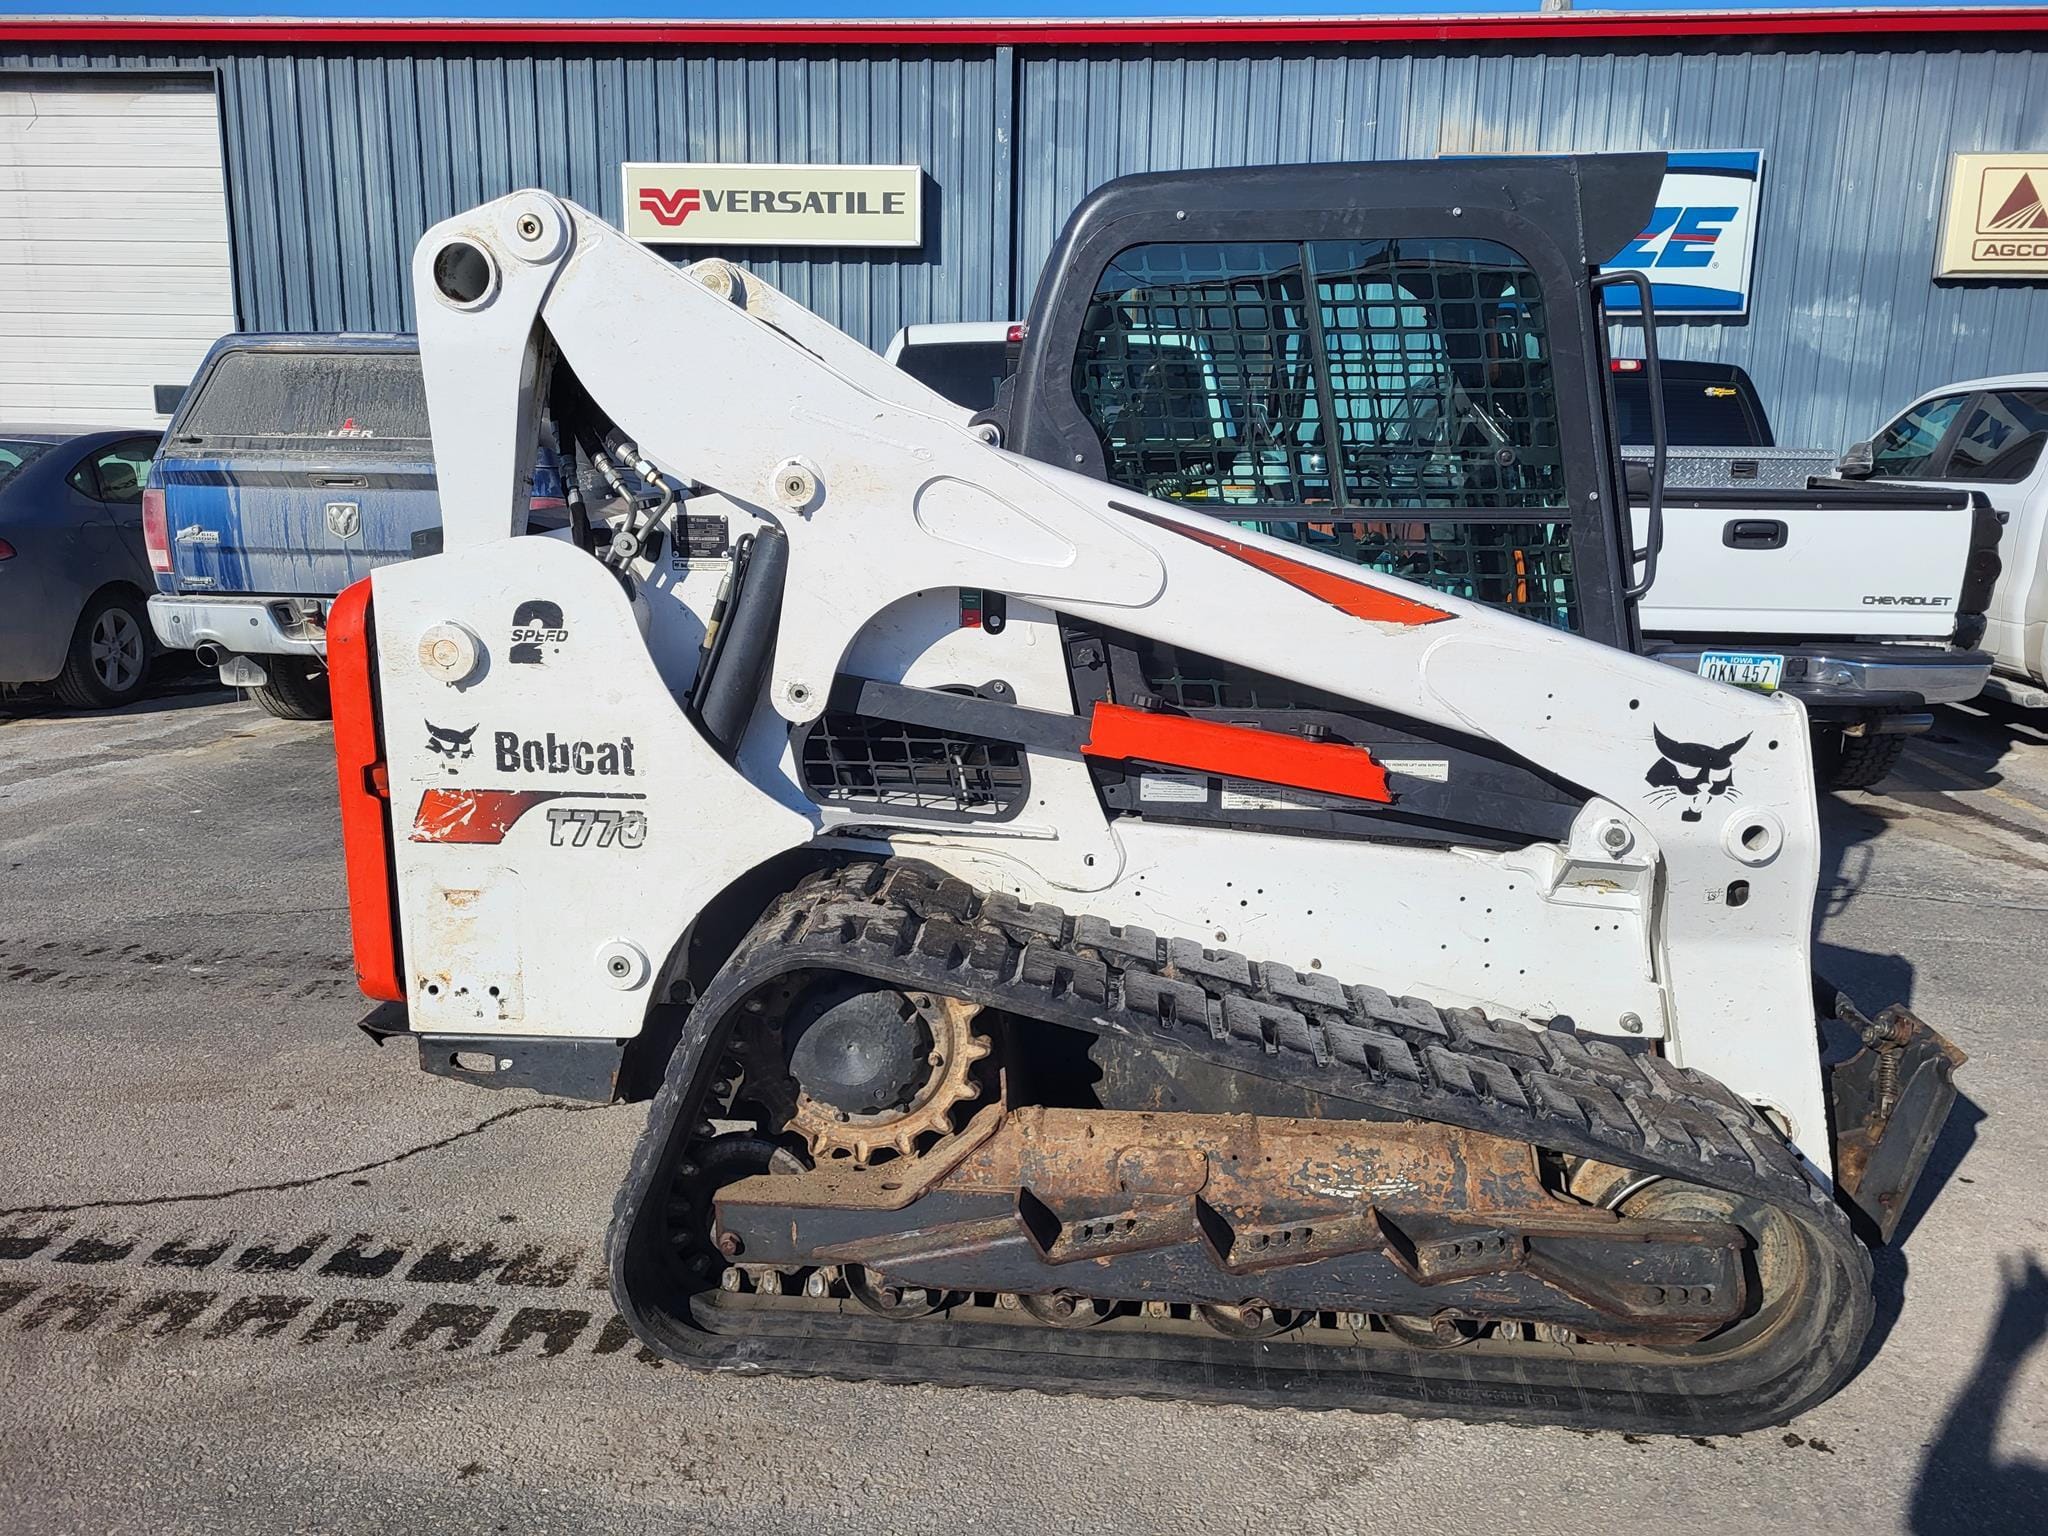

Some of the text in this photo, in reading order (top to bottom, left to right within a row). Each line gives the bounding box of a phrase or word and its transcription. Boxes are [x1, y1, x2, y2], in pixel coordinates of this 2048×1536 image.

[702, 190, 906, 214] VERSATILE
[1982, 244, 2048, 256] AGCO
[327, 430, 373, 438] LEER
[1862, 596, 1952, 606] CHEVROLET
[511, 629, 569, 642] SPEED
[1742, 665, 1770, 683] 457
[494, 731, 636, 777] Bobcat
[546, 808, 648, 849] T770
